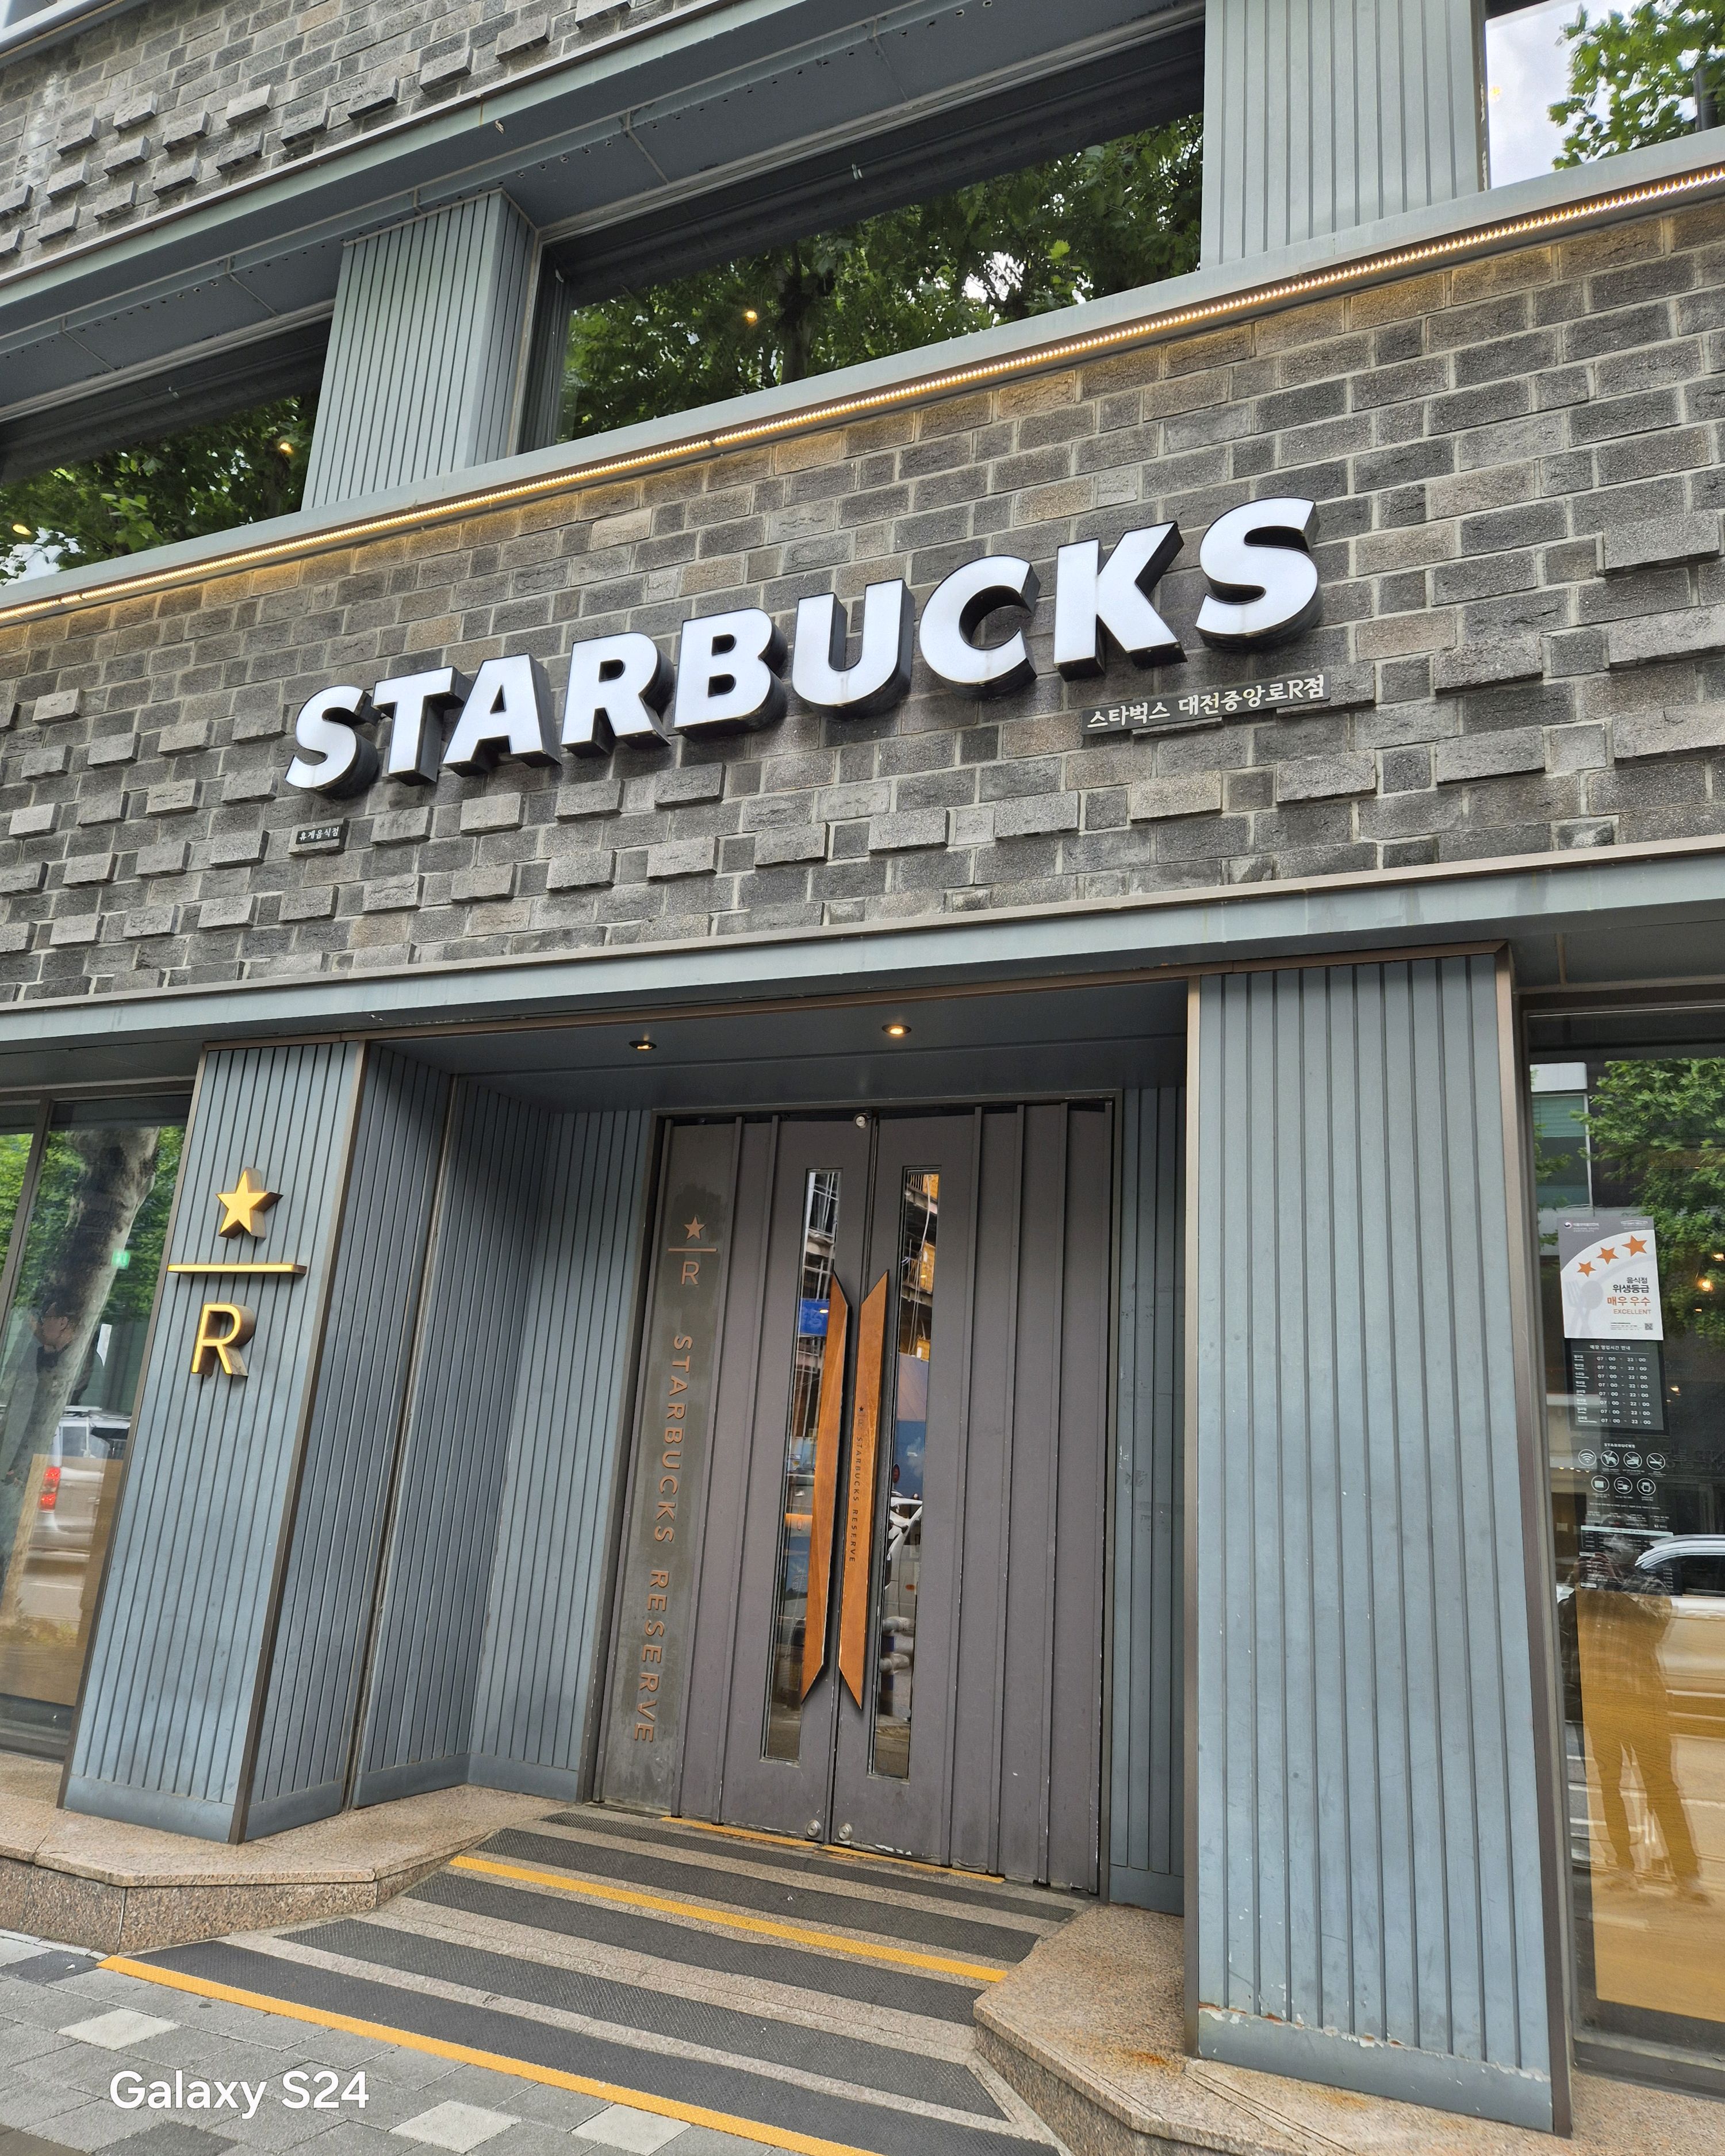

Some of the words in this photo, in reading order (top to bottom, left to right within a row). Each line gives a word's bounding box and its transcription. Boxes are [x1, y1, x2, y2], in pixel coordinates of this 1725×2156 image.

[285, 496, 1319, 791] STARBUCKS
[1086, 701, 1171, 728] 스타벅스
[1178, 674, 1324, 716] 대전중앙로R점
[299, 826, 339, 841] 휴게음식점
[680, 1261, 700, 1286] R
[1612, 1284, 1650, 1294] 위생등급
[1607, 1296, 1628, 1306] 매우
[1630, 1296, 1651, 1306] 우수
[191, 1303, 244, 1375] R
[654, 1334, 693, 1543] STARBUCKS
[853, 1437, 862, 1501] STARBUCKS
[849, 1509, 858, 1562] RESERVE
[634, 1570, 670, 1743] RESERVE
